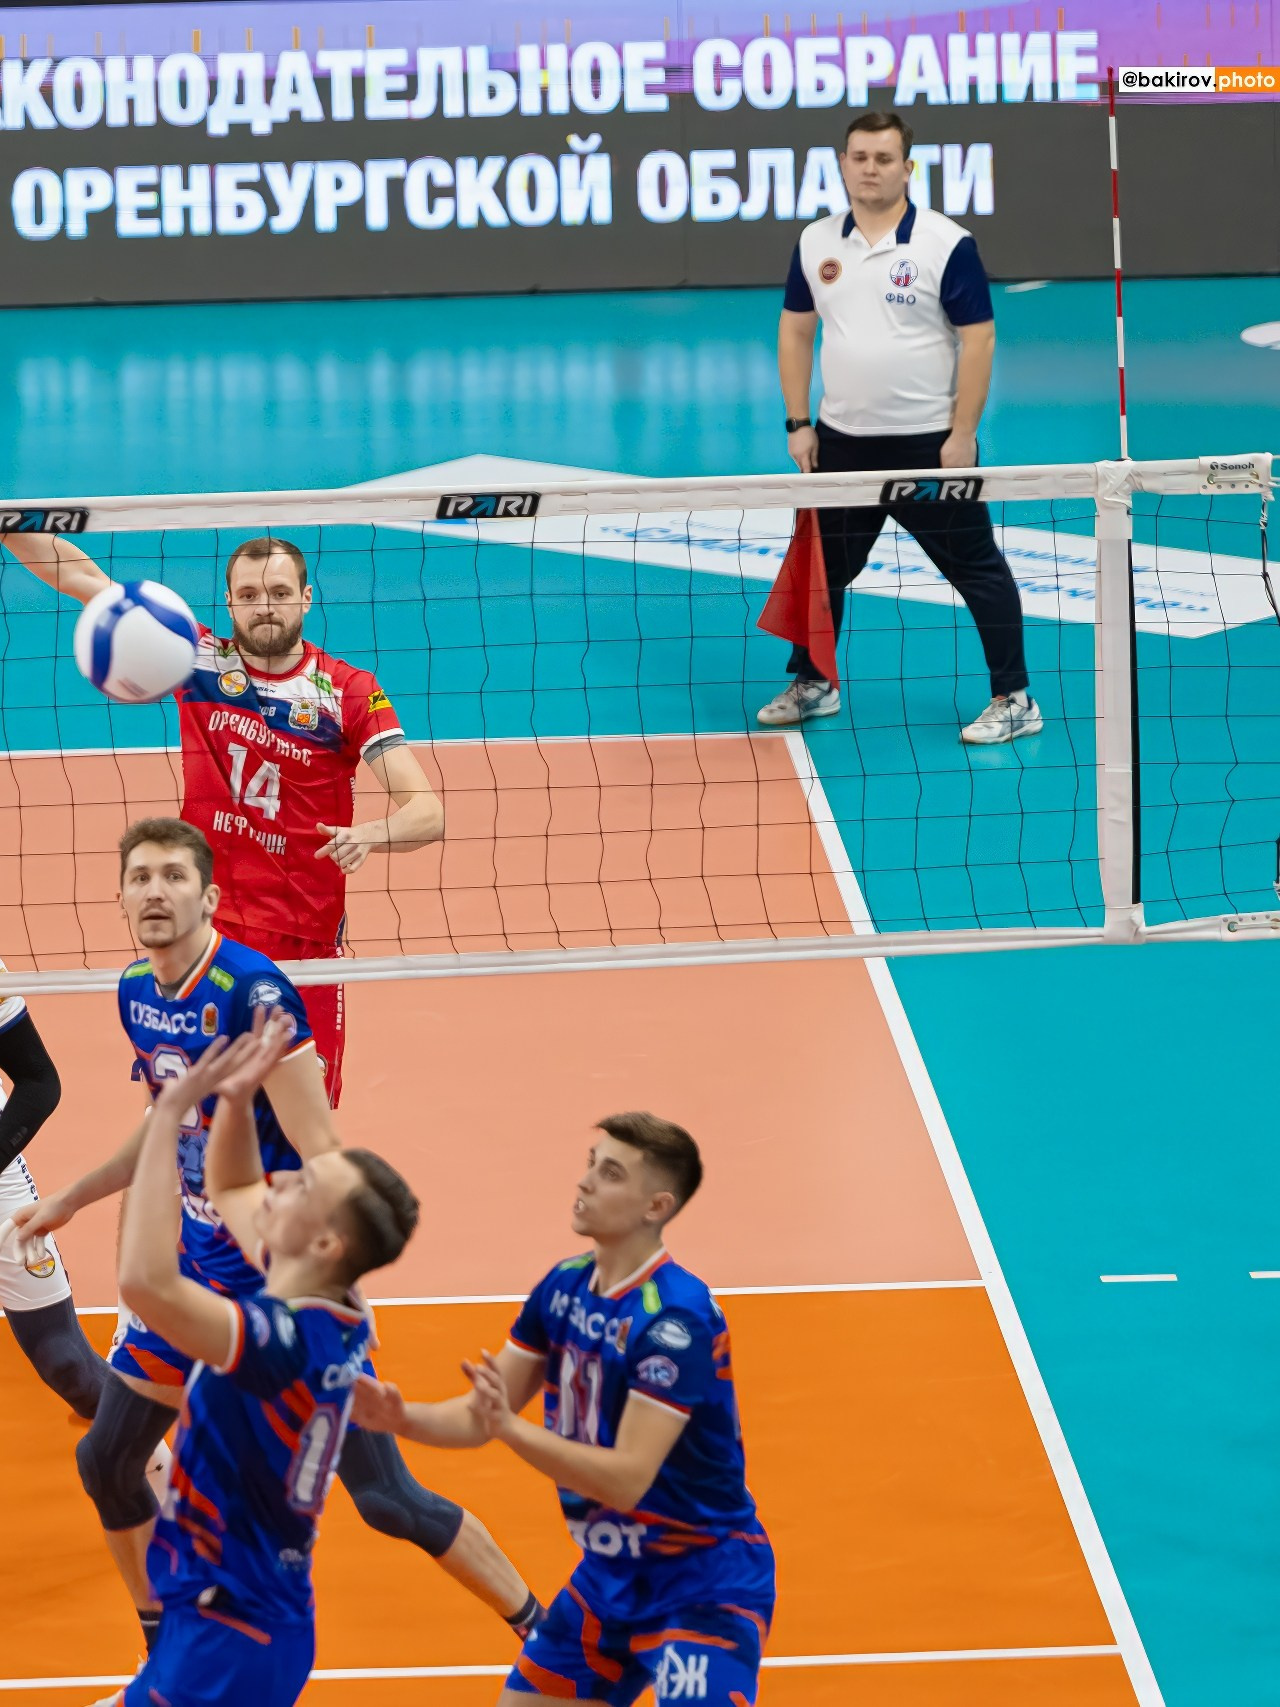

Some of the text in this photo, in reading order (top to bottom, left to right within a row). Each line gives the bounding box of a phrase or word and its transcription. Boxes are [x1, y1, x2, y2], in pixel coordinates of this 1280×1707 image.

[693, 31, 1099, 111] СОБРАНИЕ
[12, 133, 994, 240] ОРЕНБУРГСКОЙ ОБЛАТИ
[886, 293, 916, 304] ФВО
[446, 495, 532, 516] PARI
[889, 480, 975, 501] PARI
[227, 742, 280, 821] 14
